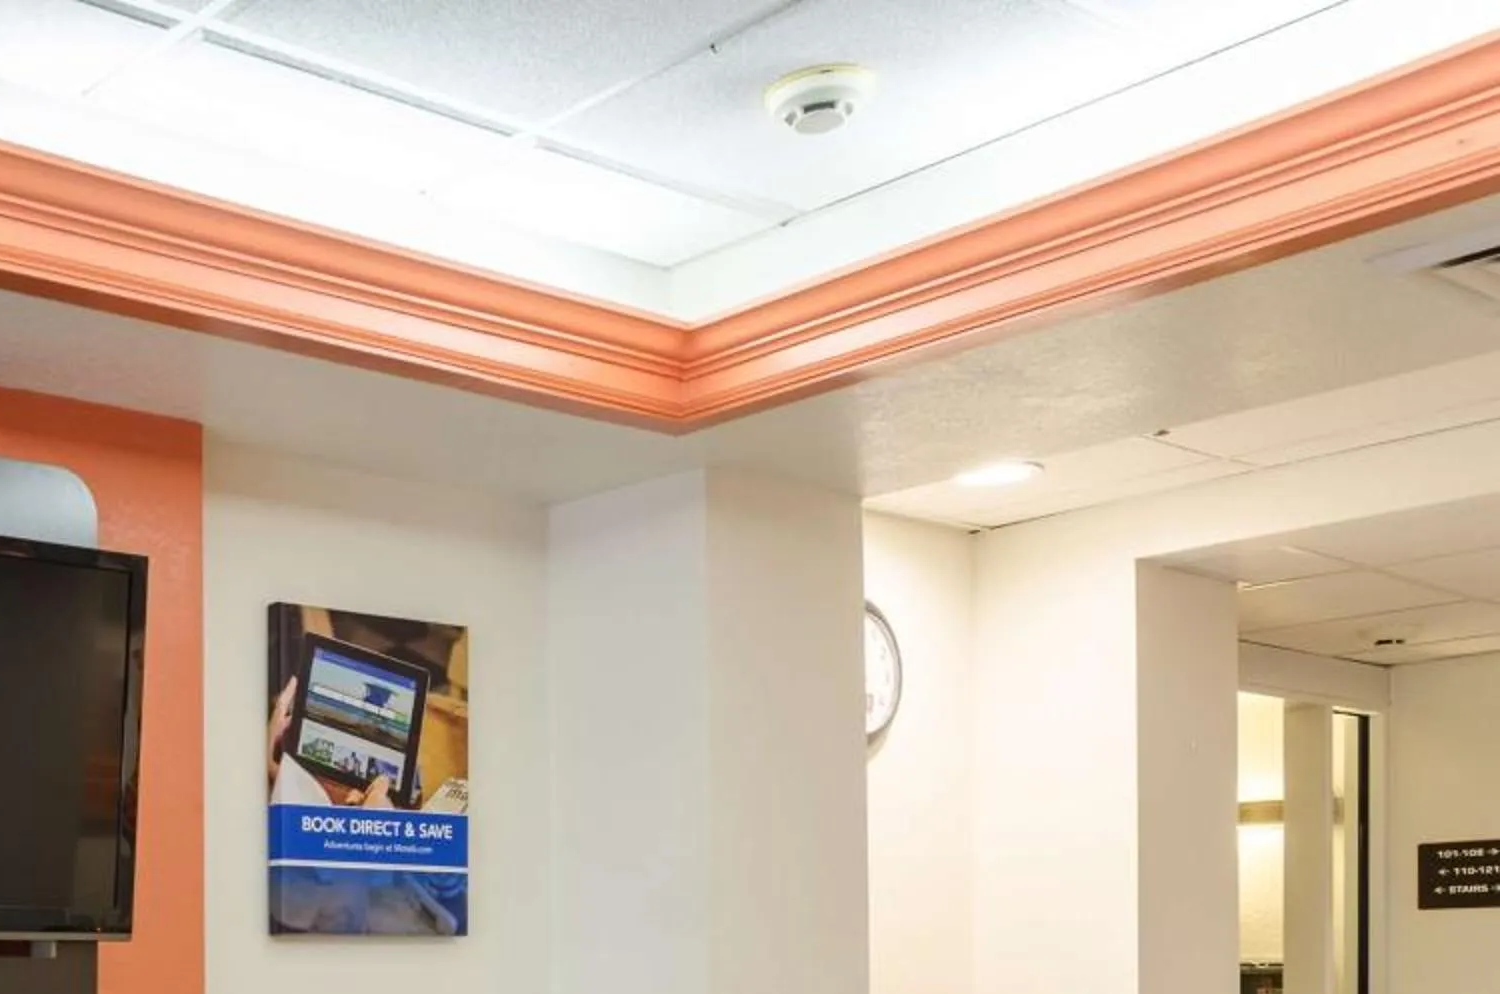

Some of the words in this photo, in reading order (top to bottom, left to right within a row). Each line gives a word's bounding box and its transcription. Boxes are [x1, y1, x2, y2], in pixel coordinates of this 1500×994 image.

[301, 815, 347, 834] BOOK
[350, 819, 402, 838] DIRECT
[404, 822, 416, 838] &
[419, 823, 453, 840] SAVE
